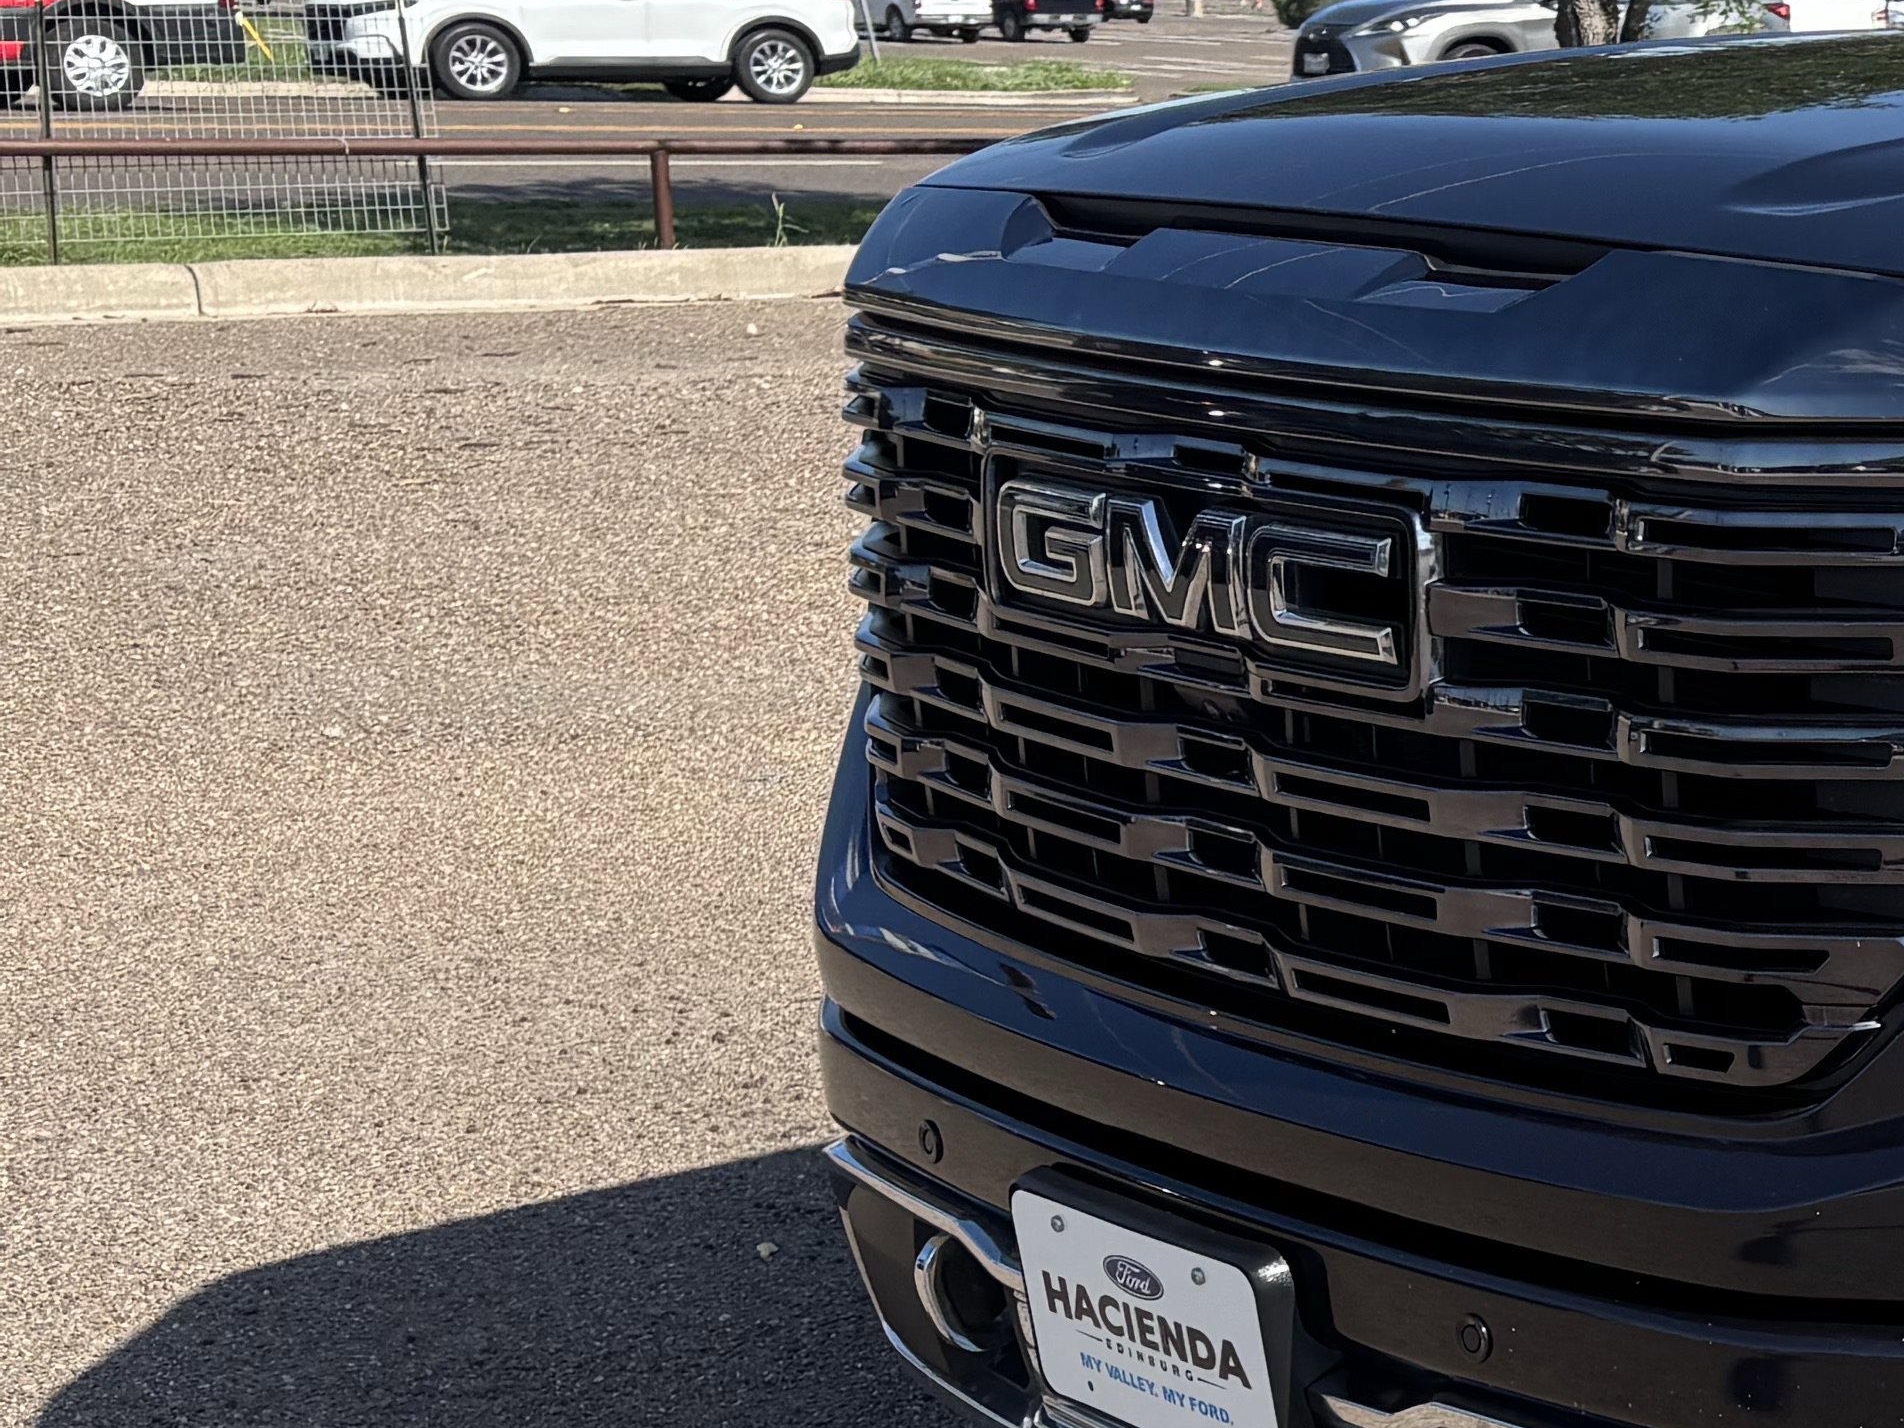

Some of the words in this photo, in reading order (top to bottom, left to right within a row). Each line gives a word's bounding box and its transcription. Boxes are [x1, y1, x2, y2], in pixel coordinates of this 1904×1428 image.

[998, 473, 1398, 666] GMC
[1116, 1260, 1152, 1296] Ford
[1042, 1270, 1253, 1390] HACIENDA
[1105, 1338, 1194, 1382] EDINBURG
[1080, 1352, 1104, 1374] MY
[1105, 1362, 1159, 1399] VALLEY.
[1162, 1386, 1188, 1408] MY
[1188, 1397, 1235, 1426] FORD.
